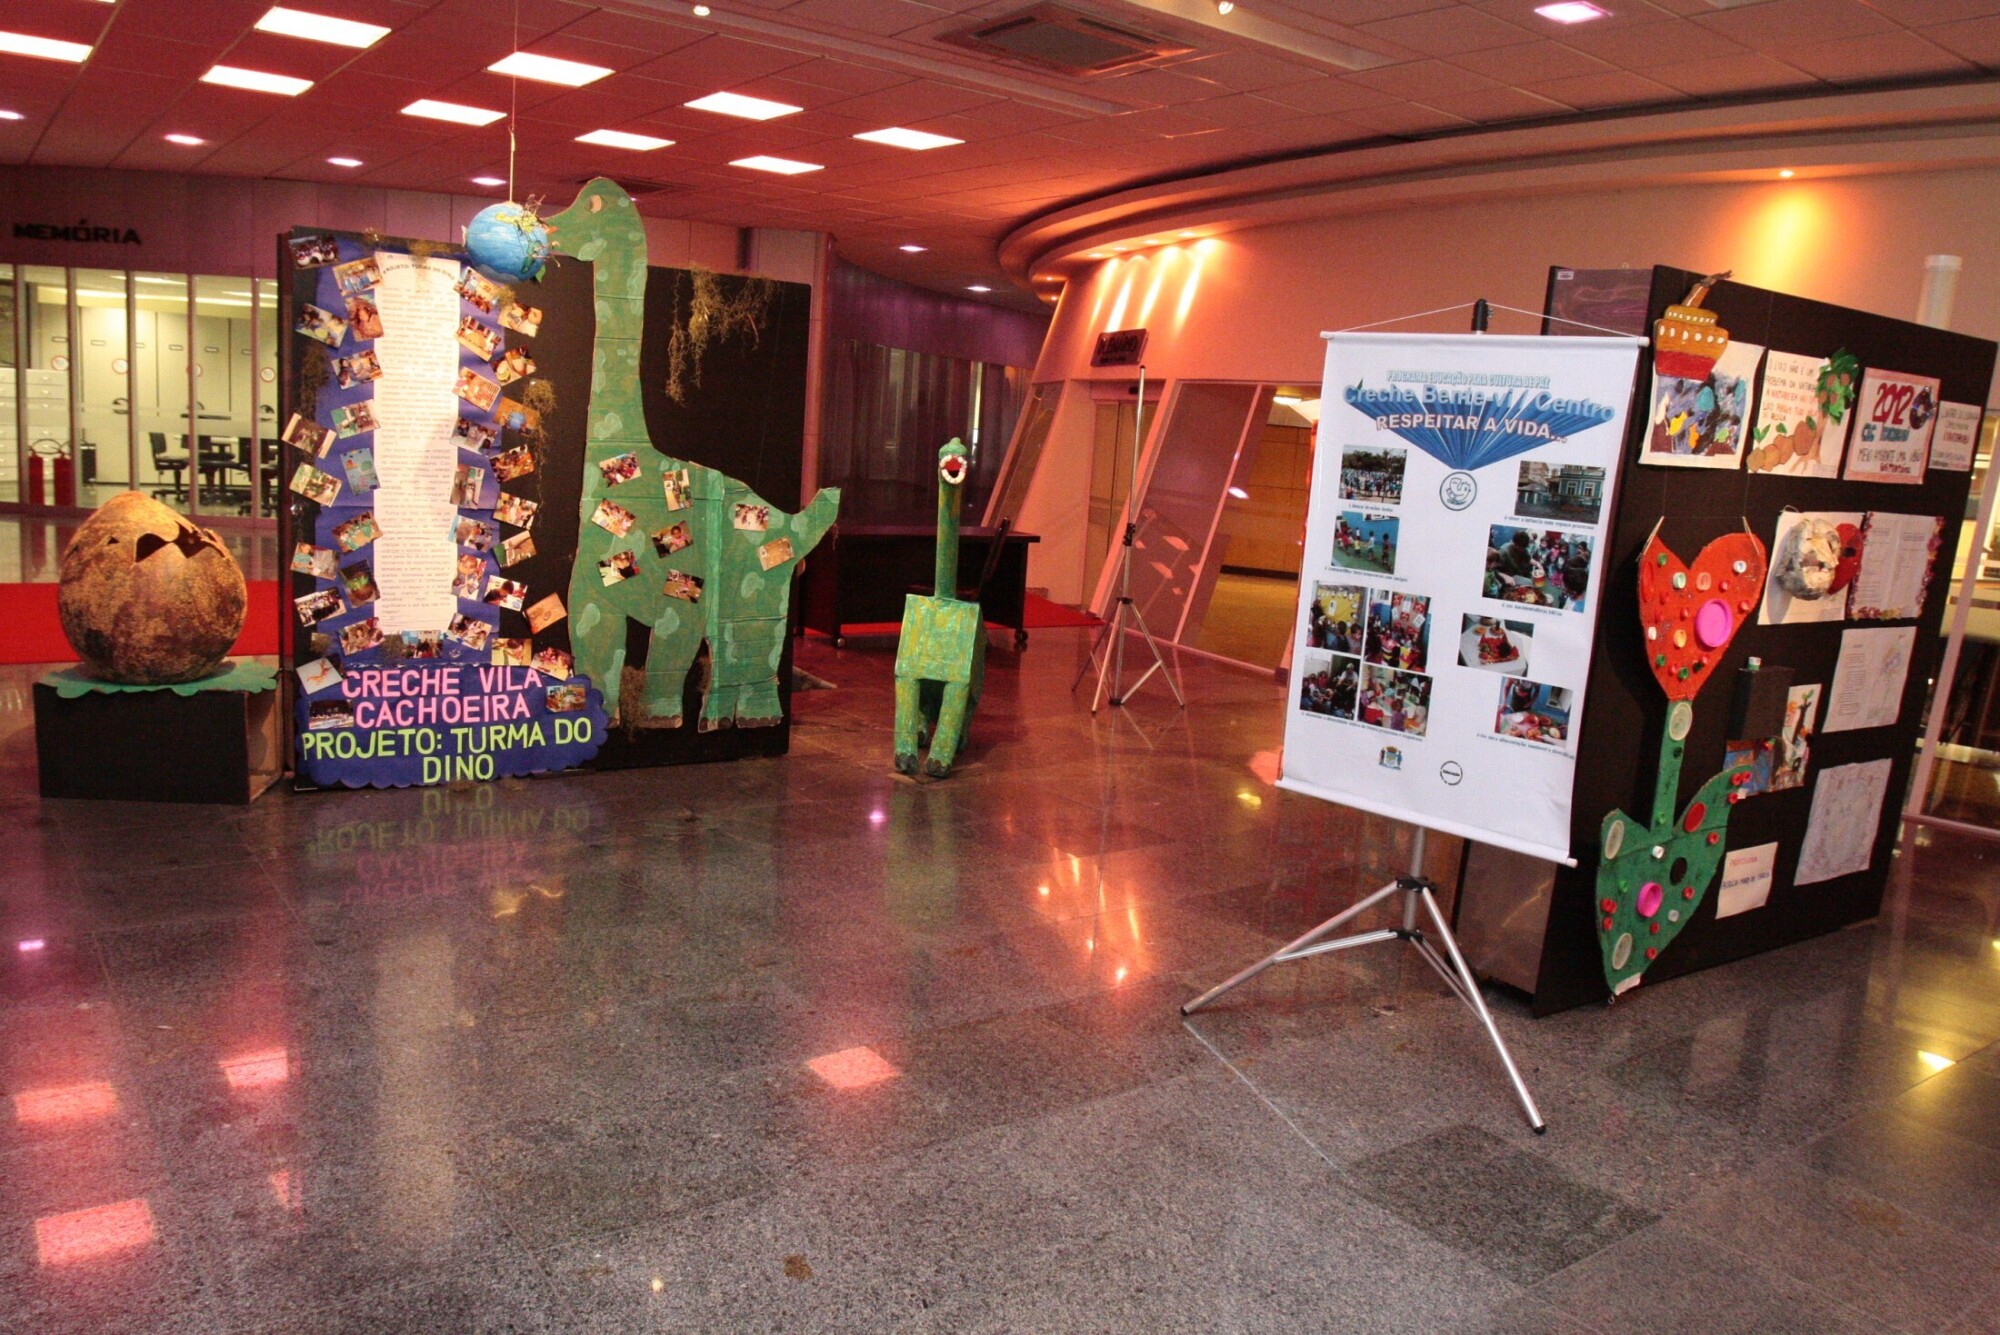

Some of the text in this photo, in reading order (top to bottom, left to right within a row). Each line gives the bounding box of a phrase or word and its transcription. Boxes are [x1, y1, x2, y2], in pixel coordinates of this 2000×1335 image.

[13, 219, 142, 246] MEMÓRIA
[1387, 370, 1551, 390] PROGRAMA EDUCAÇÃO PARA CULTURA DE PAZ
[1343, 383, 1416, 404] Creche
[1535, 390, 1616, 423] Centro
[1872, 382, 1915, 425] 2012
[1376, 413, 1567, 444] RESPEITAR A VIDA...
[342, 665, 542, 698] CRECHE VILA
[356, 693, 531, 728] CACHOEIRA
[302, 717, 592, 760] PROJETO: TURMA DO
[423, 754, 494, 783] DINO
